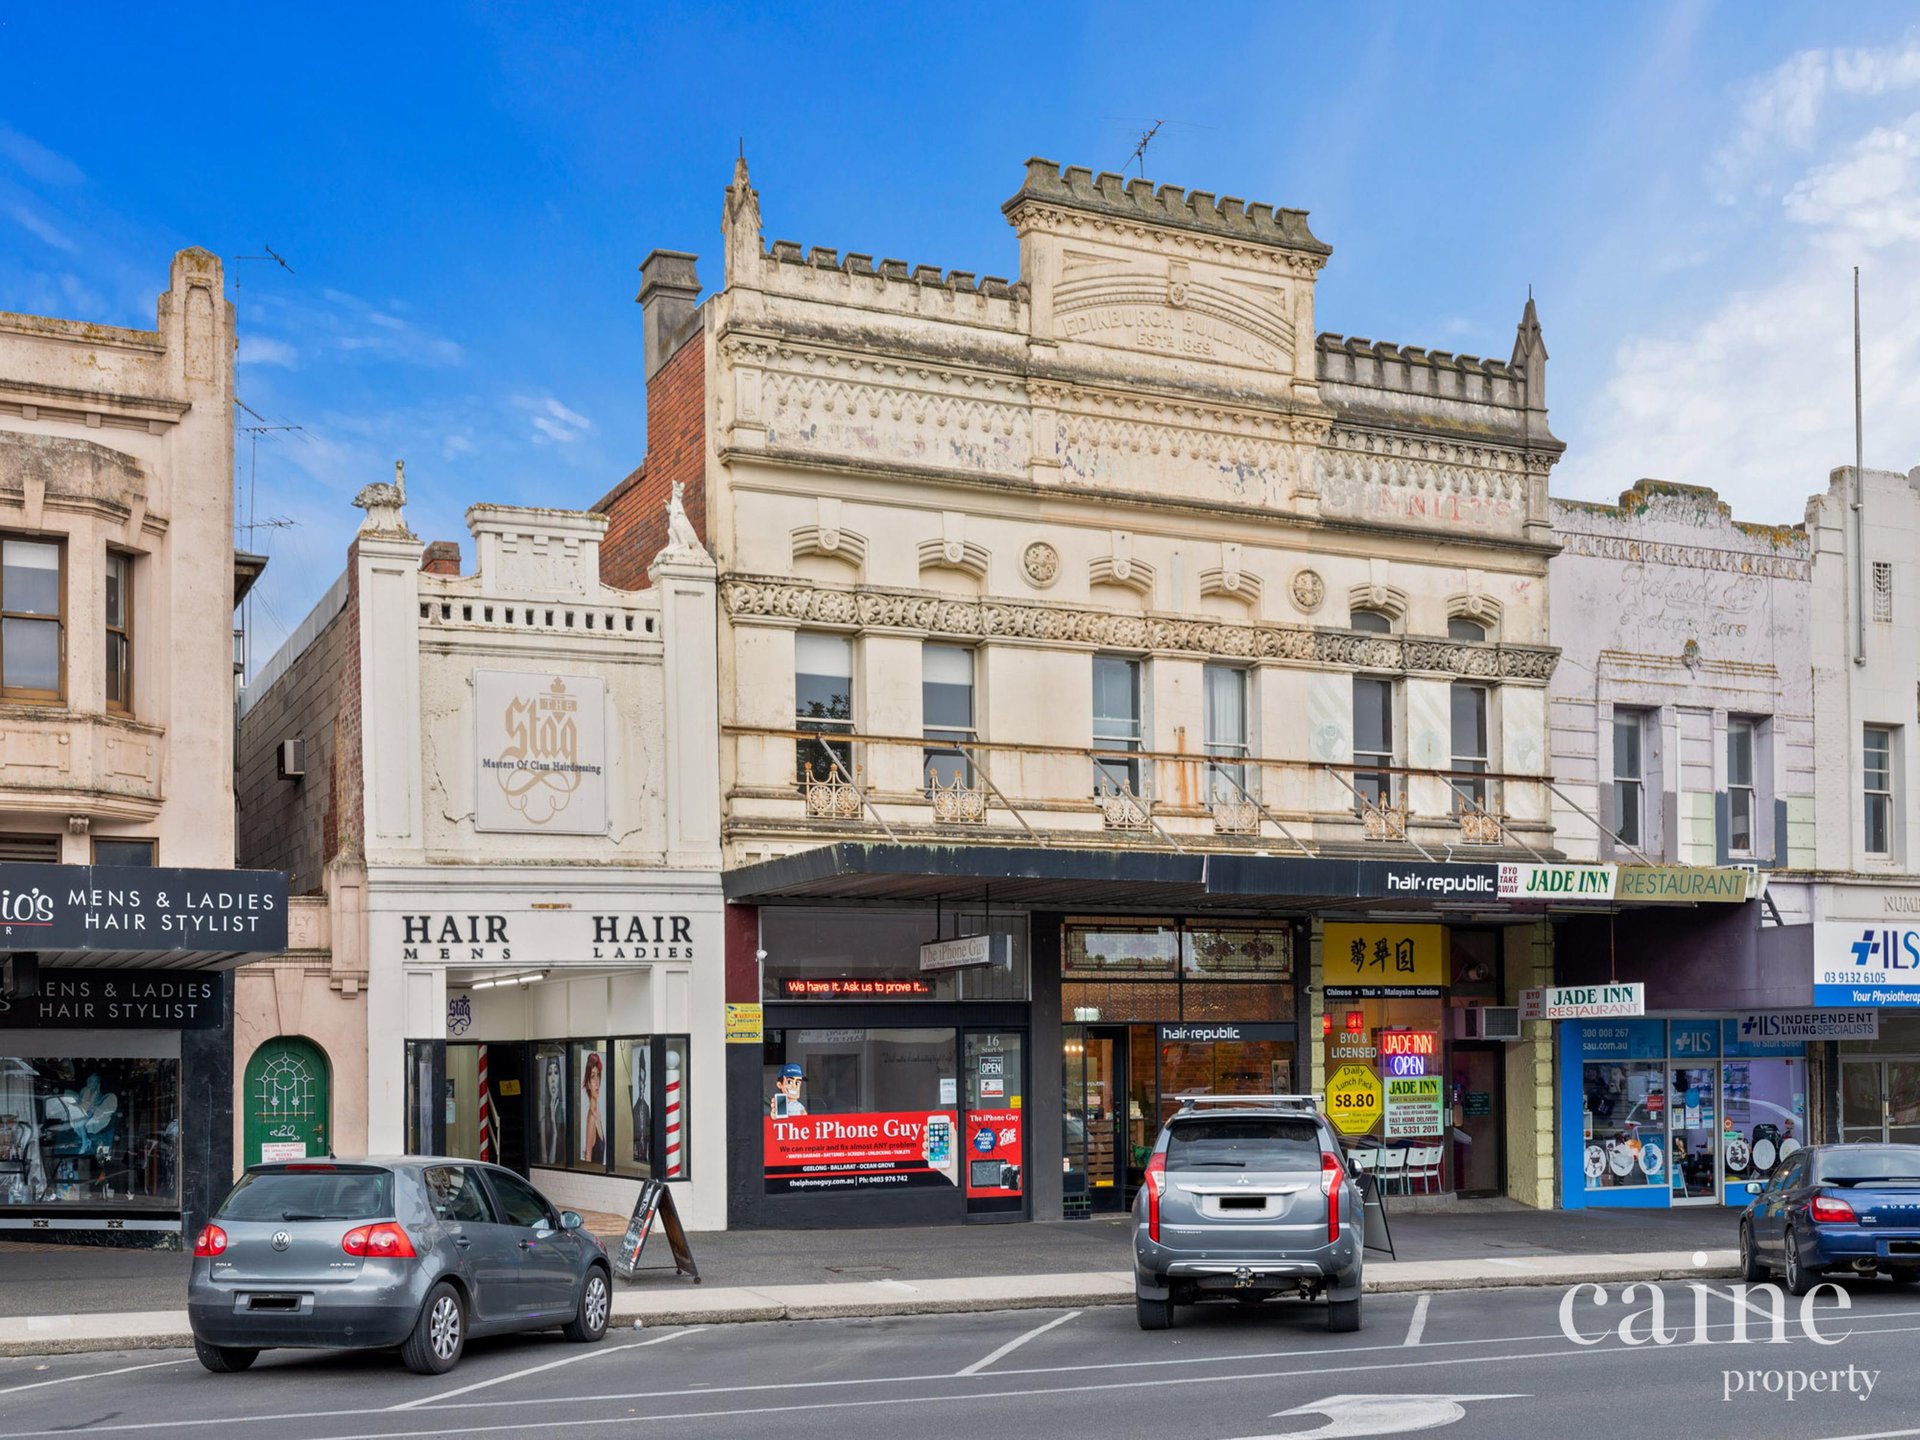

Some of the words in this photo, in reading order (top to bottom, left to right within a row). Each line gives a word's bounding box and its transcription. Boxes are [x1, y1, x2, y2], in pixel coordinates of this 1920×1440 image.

[1062, 309, 1175, 337] EDINBURGH
[1181, 312, 1278, 370] BUILDINGS
[544, 700, 574, 710] THE
[499, 695, 578, 761] Stag
[482, 758, 514, 770] Masters
[516, 760, 528, 770] Of
[530, 761, 550, 771] Class
[553, 762, 601, 775] Hairdressing
[1502, 866, 1518, 875] BYO
[1500, 875, 1518, 884] TAKE
[1526, 869, 1574, 892] JADE
[1578, 870, 1611, 893] INN
[1621, 872, 1743, 896] RESTAURANT
[68, 889, 141, 907] MENS
[156, 892, 170, 908] &
[187, 893, 274, 910] LADIES
[85, 914, 146, 930] HAIR
[161, 915, 259, 932] STYLIST
[402, 915, 510, 944] HAIR
[592, 916, 693, 944] HAIR
[404, 948, 511, 960] MENS
[594, 947, 693, 958] LADIES
[922, 947, 937, 964] The
[939, 943, 967, 961] iPhone
[969, 940, 986, 957] Guy
[1883, 930, 1920, 969] ILS
[1824, 972, 1836, 983] 03
[1838, 972, 1861, 983] 9132
[1863, 972, 1886, 983] 6105
[32, 982, 90, 997] ENS
[105, 983, 117, 997] &
[133, 984, 212, 998] LADIES
[788, 981, 805, 992] We
[807, 981, 829, 992] have
[843, 981, 860, 992] Ask
[861, 983, 873, 992] us
[874, 982, 884, 992] to
[885, 983, 911, 994] prove
[1326, 988, 1352, 996] Chinese
[1361, 988, 1375, 996] Thai
[1384, 988, 1415, 997] Malaysian
[1416, 988, 1440, 996] Cuisine
[1526, 991, 1540, 1000] BYO
[1553, 989, 1598, 1006] JADE
[1603, 987, 1633, 1003] INN
[1852, 991, 1871, 1002] Your
[40, 1003, 95, 1018] HAIR
[109, 1004, 197, 1018] STYLIST
[1548, 1004, 1639, 1017] RESTAURANT
[1759, 1015, 1780, 1036] ILS
[1782, 1013, 1873, 1025] INDEPENDENT
[1782, 1026, 1816, 1035] LIVING
[1817, 1024, 1874, 1035] SPECIALISTS
[986, 1035, 999, 1047] 16
[1340, 1033, 1359, 1044] BYO
[1361, 1033, 1368, 1043] &
[1385, 1034, 1412, 1054] JADE
[1413, 1034, 1432, 1054] INN
[1691, 1032, 1711, 1052] ILS
[1331, 1047, 1377, 1059] LICENSED
[981, 1062, 1001, 1073] OPEN
[1343, 1066, 1366, 1077] Daily
[1394, 1056, 1424, 1075] OPEN
[1336, 1077, 1357, 1091] Lunch
[1358, 1078, 1373, 1090] Pack
[1389, 1080, 1417, 1095] JADE
[1419, 1080, 1438, 1094] INN
[1335, 1093, 1374, 1108] $8.80
[970, 1114, 982, 1122] The
[1005, 1113, 1019, 1122] Guy
[773, 1122, 810, 1141] The
[815, 1120, 879, 1140] iPhone
[883, 1119, 922, 1141] Guy
[1390, 1126, 1402, 1134] Tel.
[1403, 1126, 1420, 1134] 5331
[1422, 1125, 1438, 1133] 2011
[779, 1145, 791, 1153] We
[804, 1144, 824, 1153] repair
[825, 1143, 839, 1151] and
[840, 1143, 848, 1151] fix
[850, 1142, 872, 1151] almost
[889, 1141, 917, 1150] problem
